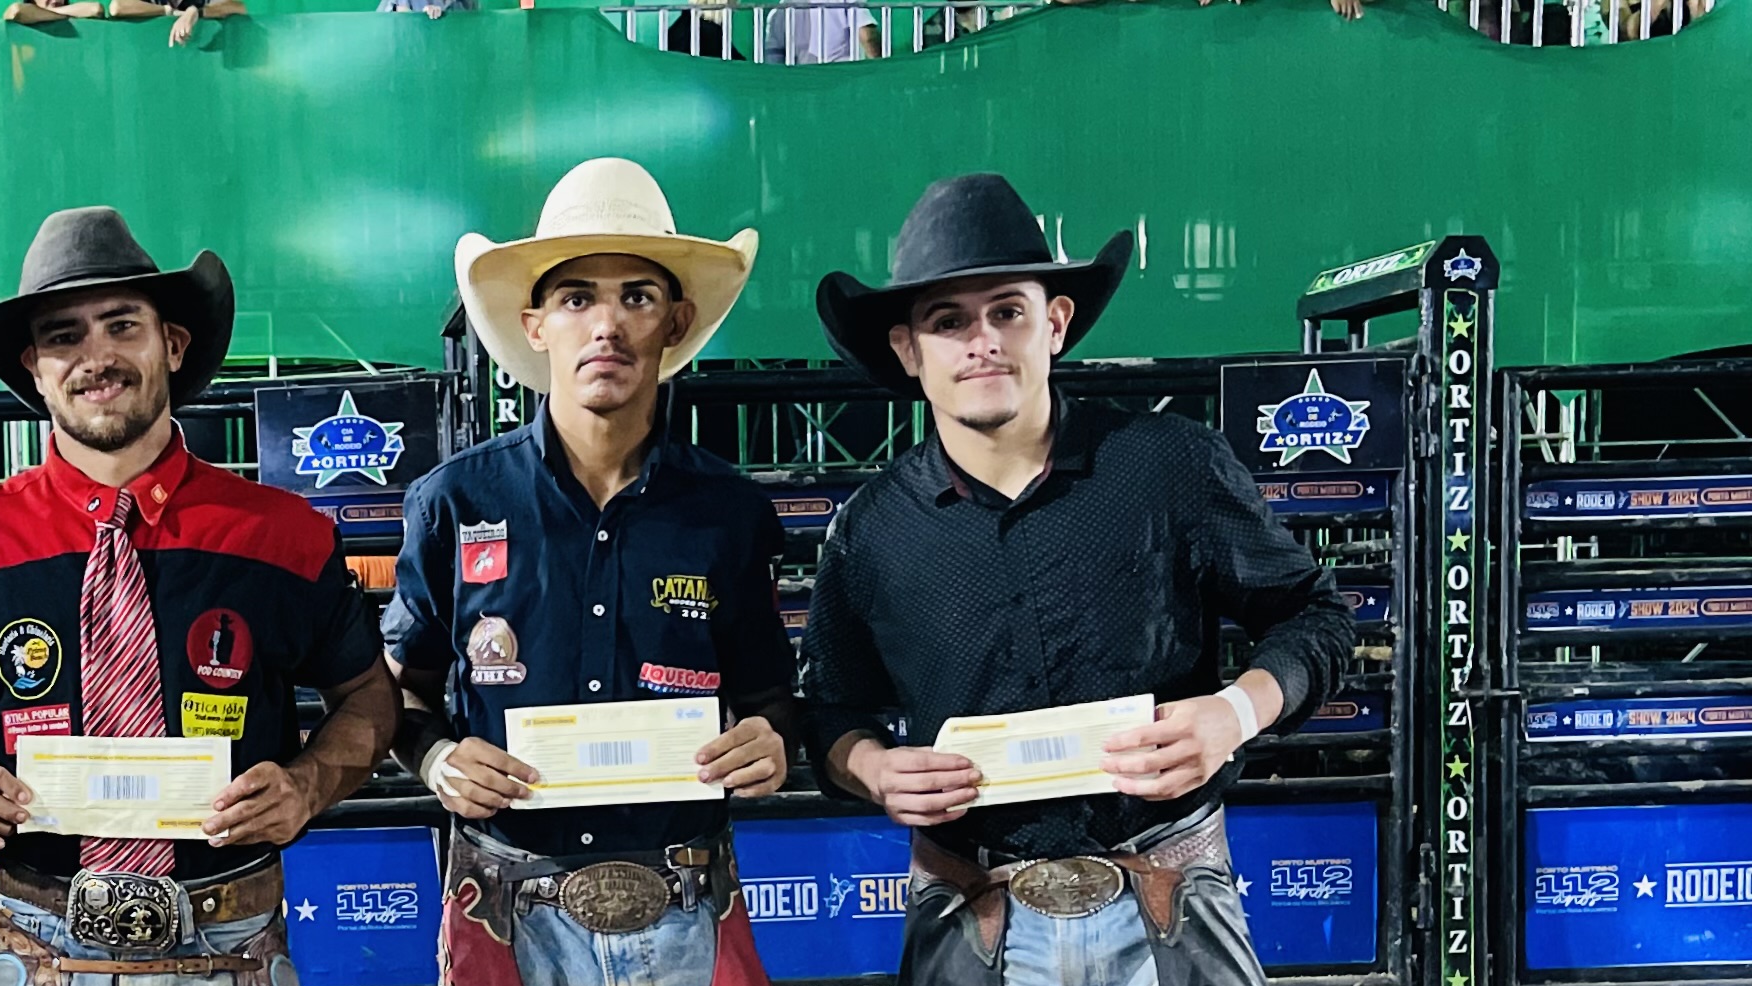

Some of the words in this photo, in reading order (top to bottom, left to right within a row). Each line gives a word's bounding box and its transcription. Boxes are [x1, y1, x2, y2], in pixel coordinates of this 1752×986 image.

[1333, 253, 1406, 285] ORTIZ
[1285, 432, 1344, 446] ORTIZ
[1448, 349, 1471, 511] ORTIZ
[320, 454, 380, 468] ORTIZ
[1576, 492, 1615, 509] RODEIO
[1630, 490, 1663, 507] SHOW
[1668, 489, 1698, 505] 2024
[682, 609, 710, 620] 202
[1576, 602, 1616, 620] RODEIO
[1630, 600, 1663, 617] SHOW
[1668, 599, 1698, 616] 2024
[1447, 565, 1469, 726] ORTIZ
[31, 707, 69, 720] POPULAR
[1575, 710, 1614, 728] RODEIO
[1629, 709, 1661, 726] SHOW
[1666, 708, 1696, 725] 2024
[1271, 865, 1352, 892] 112
[1446, 796, 1469, 954] ORTIZ
[1570, 865, 1618, 873] MURTINHO
[741, 882, 819, 918] ODEIO
[859, 878, 909, 912] SHO
[1535, 873, 1619, 902] 112
[336, 890, 418, 916] 112
